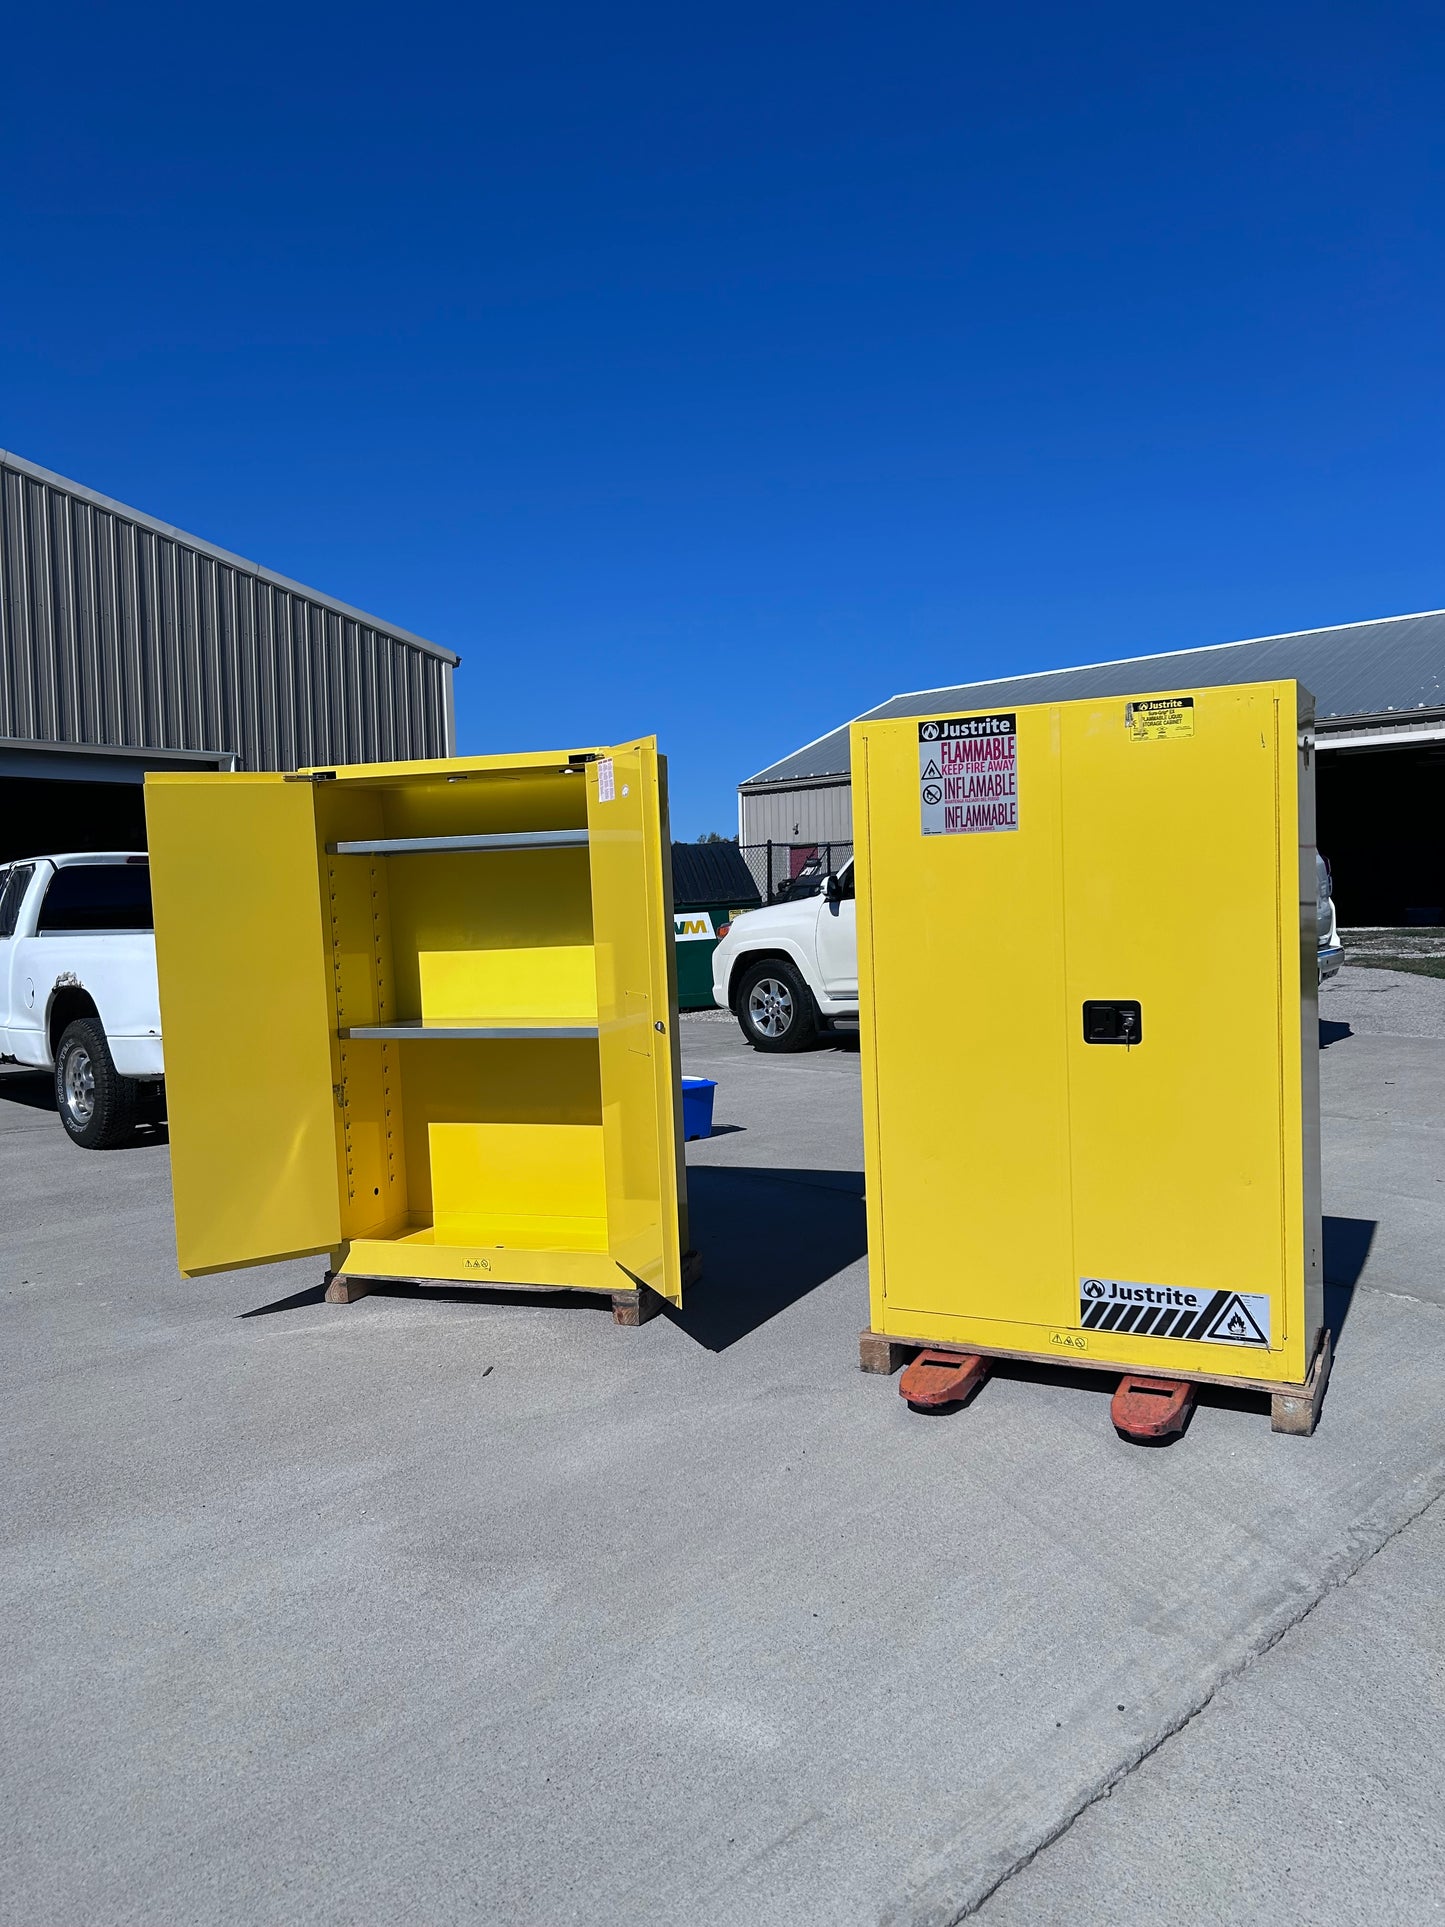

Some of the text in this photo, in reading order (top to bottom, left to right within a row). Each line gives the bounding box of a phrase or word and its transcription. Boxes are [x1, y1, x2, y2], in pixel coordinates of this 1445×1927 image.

[1149, 700, 1183, 710] Justrite
[941, 717, 1011, 738] Justrite
[941, 736, 1015, 764] FLAMMABLE
[941, 759, 1015, 776] KEEP FIRE AWAY
[944, 773, 1016, 800] INFLAMABLE
[944, 802, 1016, 828] INFLAMMABLE
[1108, 1283, 1198, 1307] Justrite
